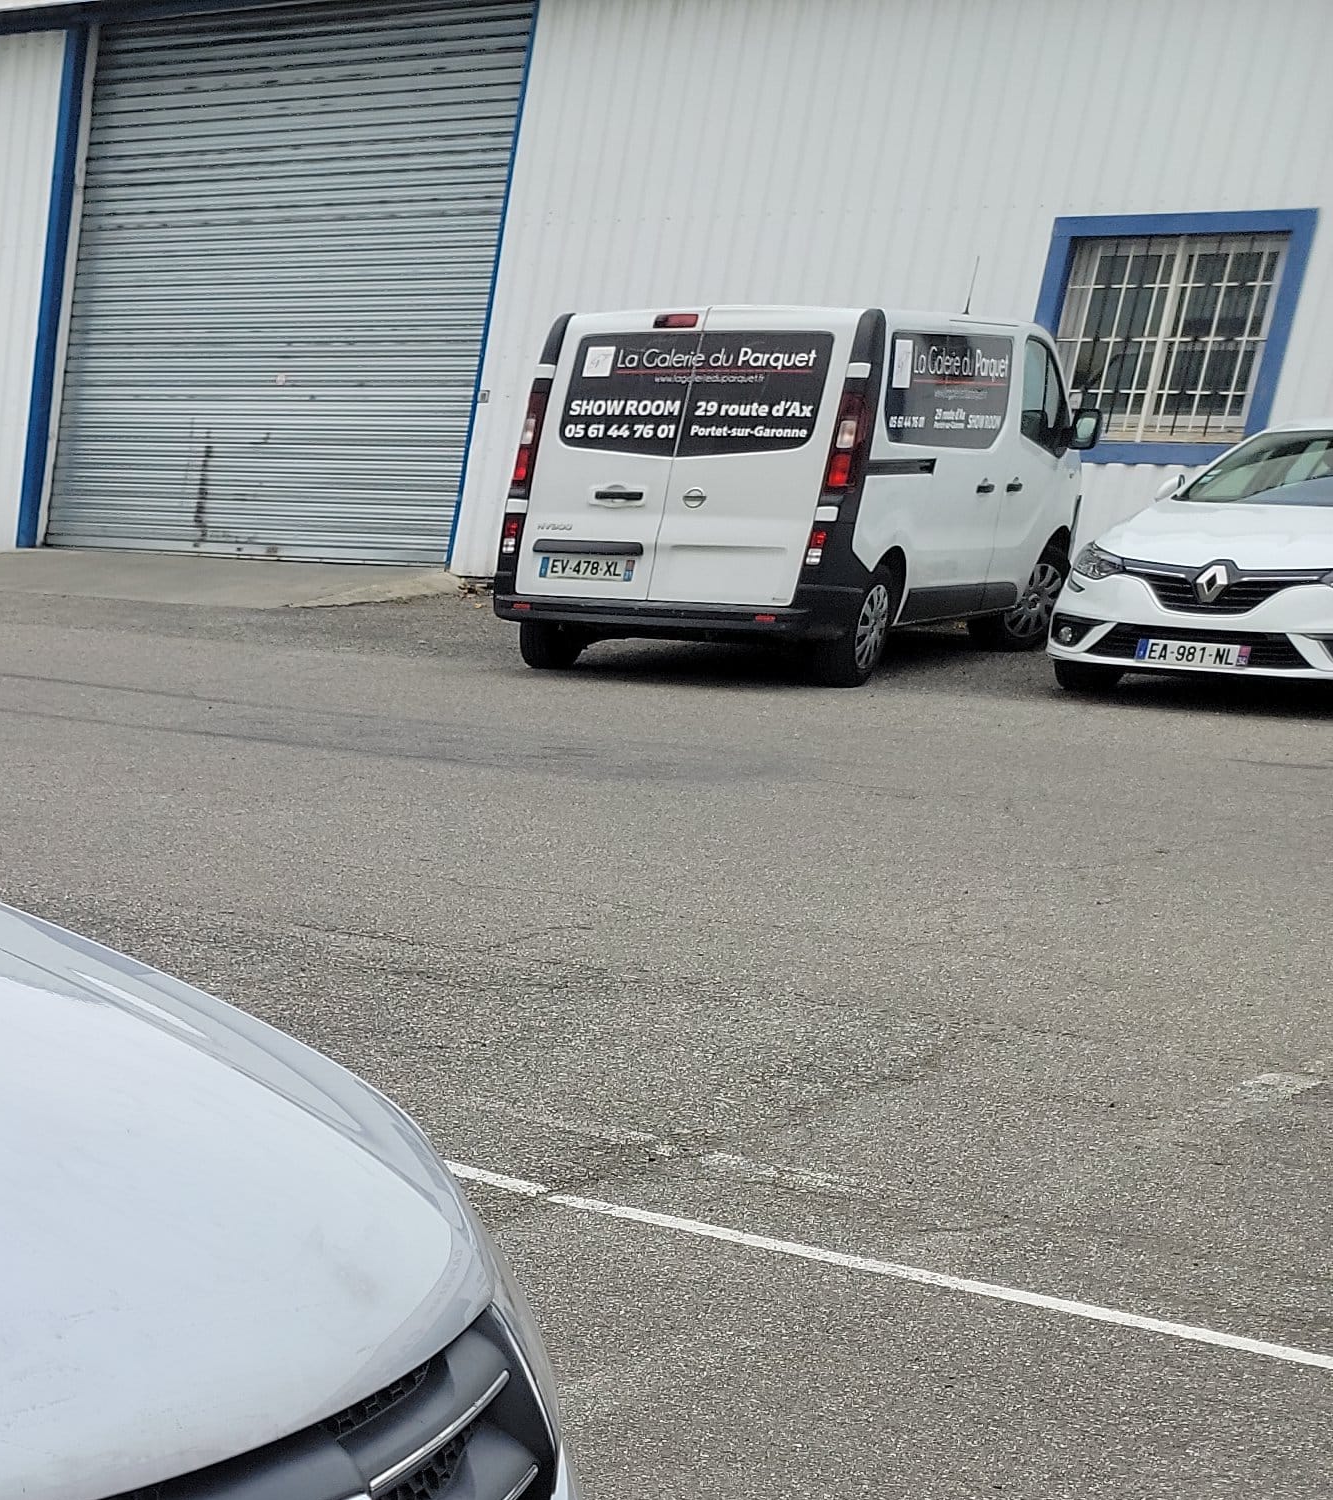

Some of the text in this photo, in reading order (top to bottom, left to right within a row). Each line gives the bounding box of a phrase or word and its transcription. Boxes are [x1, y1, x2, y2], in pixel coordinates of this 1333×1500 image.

[617, 348, 817, 370] La Galerie du Parquet
[975, 349, 1009, 382] Parquet
[694, 401, 718, 416] 29
[720, 402, 769, 417] route
[564, 424, 676, 439] 05 61 44 76 01
[690, 425, 808, 438] Portet-sur-Garonne
[1147, 642, 1235, 666] EA-981-NL
